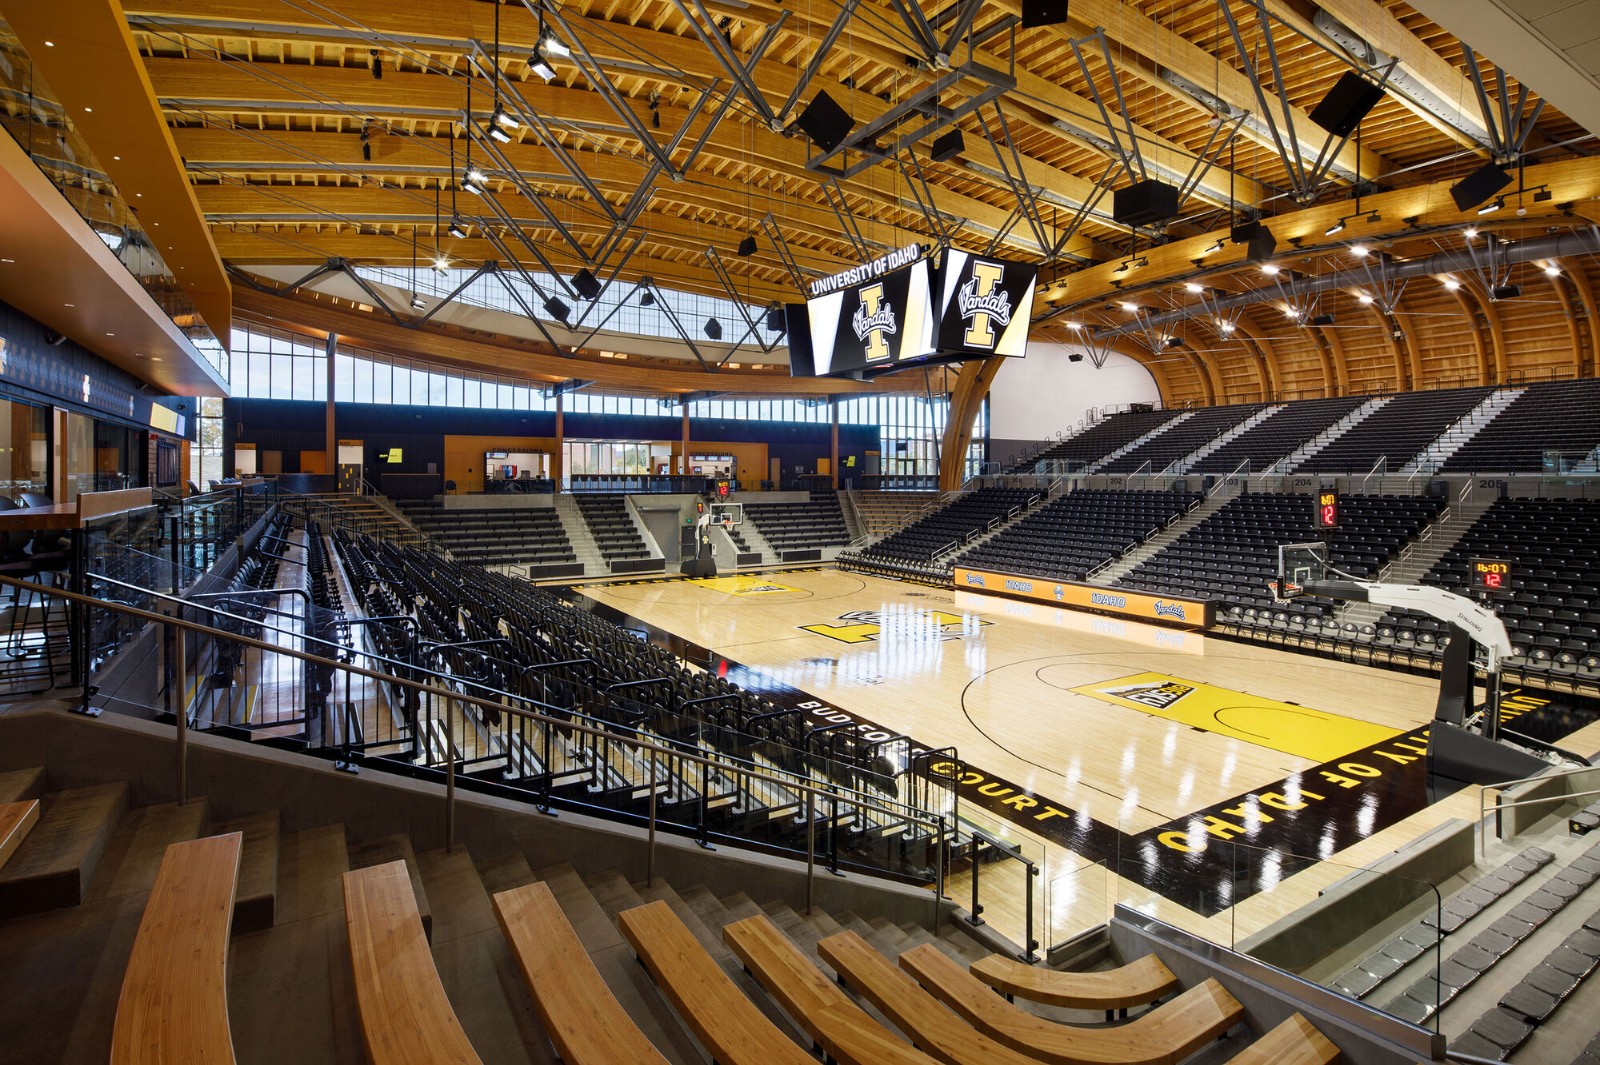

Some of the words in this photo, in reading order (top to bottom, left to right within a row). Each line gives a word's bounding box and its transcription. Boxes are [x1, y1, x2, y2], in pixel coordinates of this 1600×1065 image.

[811, 262, 873, 295] UNIVERSITY
[873, 258, 888, 275] OF
[887, 243, 918, 270] IDAHO
[957, 279, 1012, 327] Vandals
[851, 302, 897, 342] Vandals
[1294, 479, 1312, 487] 204
[1480, 480, 1503, 489] 205
[1323, 506, 1334, 524] 12
[1477, 563, 1508, 574] 16:07
[1005, 579, 1033, 593] IDAHO
[1485, 574, 1501, 587] 12
[1091, 592, 1126, 609] IDAHO
[1154, 600, 1186, 621] Vandals
[1456, 611, 1484, 633] SPALDING
[1126, 689, 1178, 708] SKY
[796, 700, 852, 724] BUD
[929, 761, 1070, 822] COURT
[1318, 761, 1383, 789] OF
[1156, 784, 1327, 854] IDAHO
